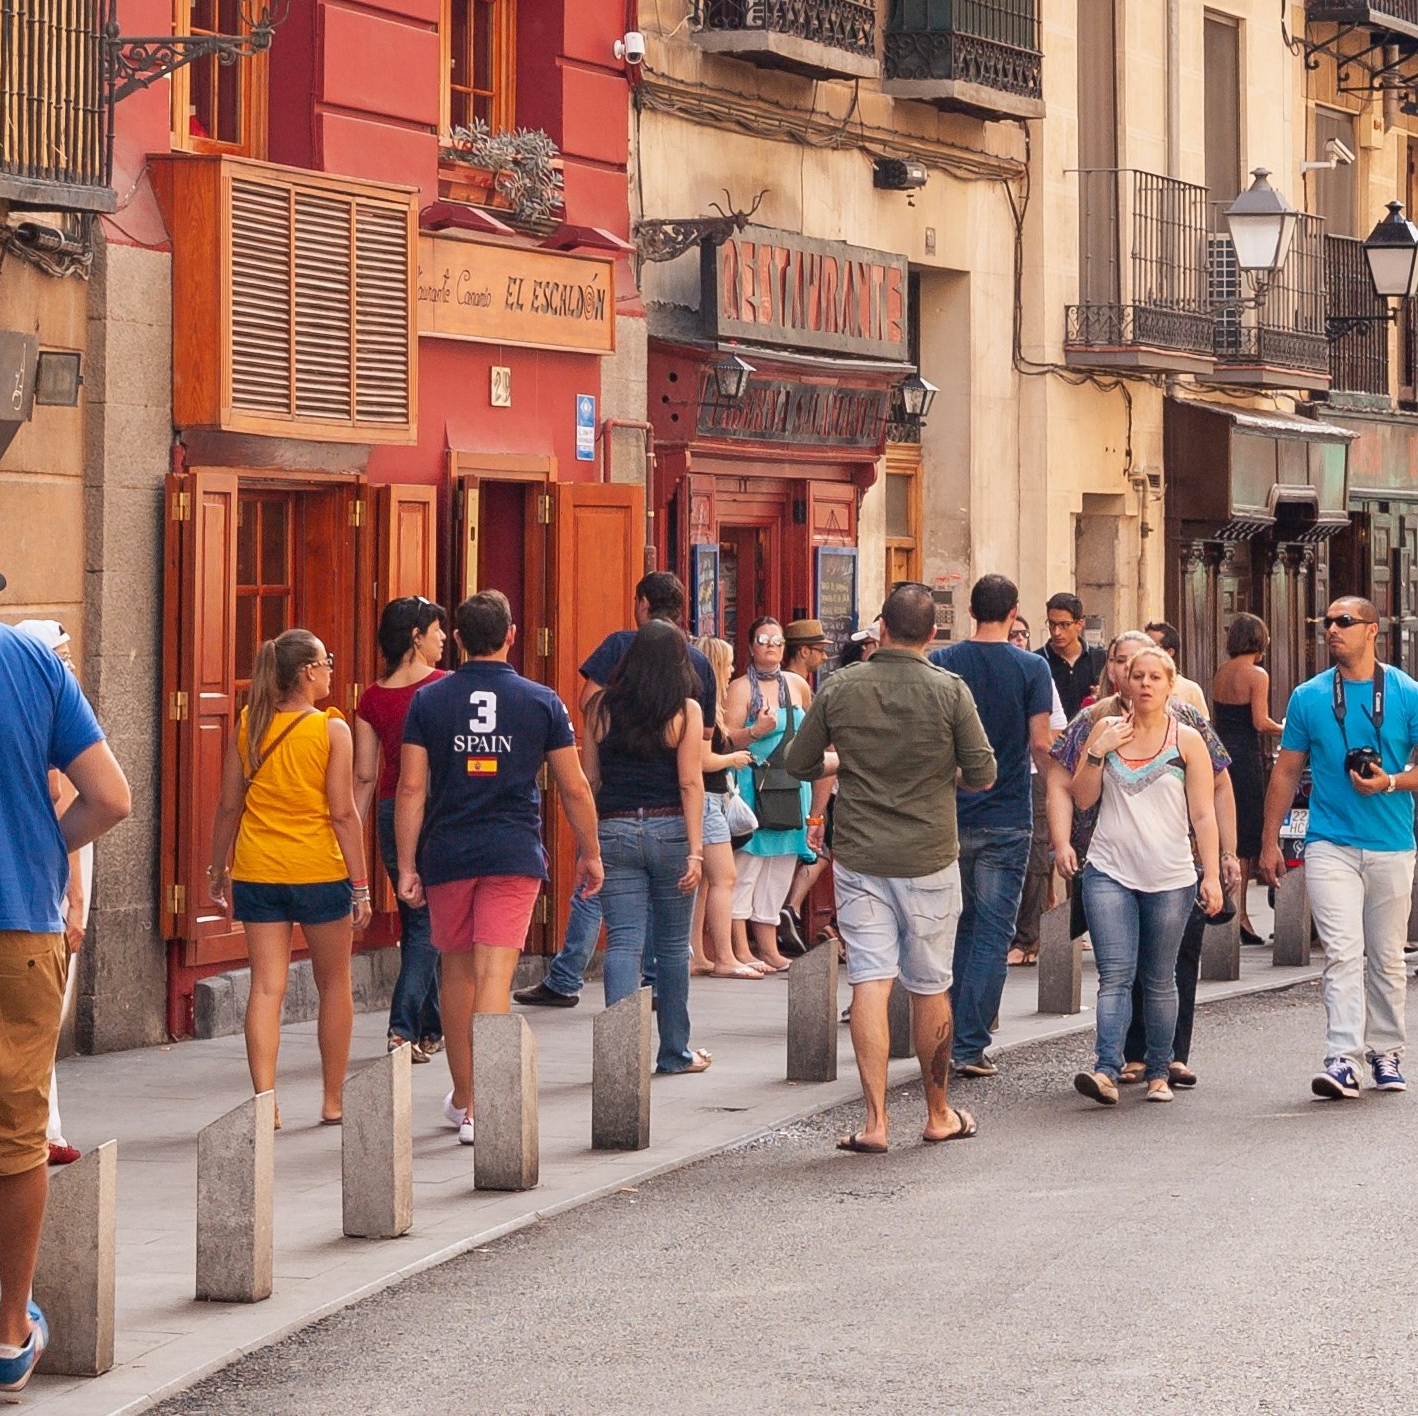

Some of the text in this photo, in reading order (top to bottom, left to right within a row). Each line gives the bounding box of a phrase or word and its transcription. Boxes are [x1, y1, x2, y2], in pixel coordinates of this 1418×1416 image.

[505, 275, 526, 312] EL
[530, 273, 607, 321] ESCALDÓN
[723, 239, 903, 344] RESTAURANTE
[493, 370, 511, 404] 29
[469, 690, 497, 733] 3
[453, 734, 512, 753] SPAIN
[1290, 823, 1305, 834] HC
[1292, 810, 1308, 822] 22
